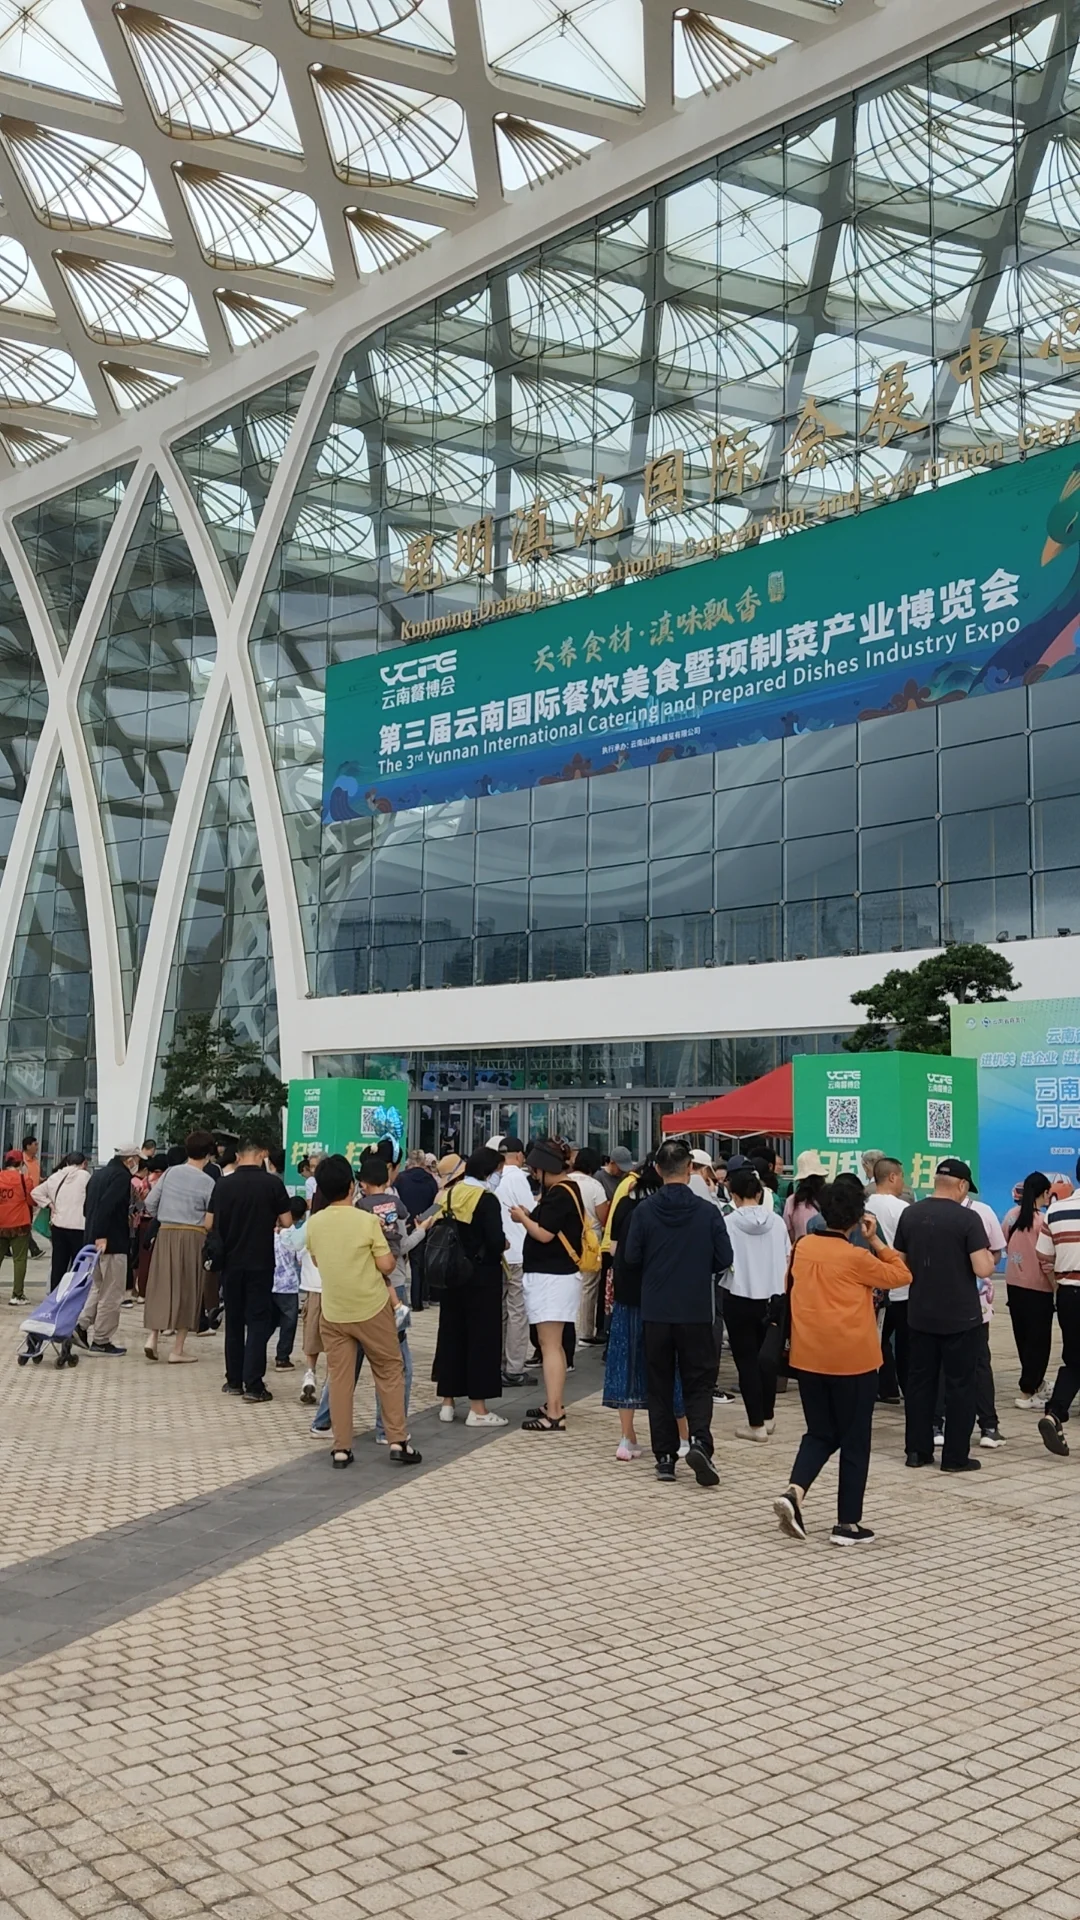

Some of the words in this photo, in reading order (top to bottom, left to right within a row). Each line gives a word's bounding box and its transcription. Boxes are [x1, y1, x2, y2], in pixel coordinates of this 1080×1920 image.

[404, 306, 1080, 593] 昆明滇池国际会展中心
[401, 608, 473, 640] Kunming
[479, 583, 543, 620] Dianchi
[550, 544, 672, 600] International
[683, 506, 805, 559] Convention
[817, 482, 861, 517] and
[873, 443, 1004, 500] Exhibition
[378, 758, 403, 775] The
[406, 751, 424, 770] 3rd
[427, 744, 479, 765] Yunnan
[483, 717, 584, 754] International
[588, 703, 659, 733] Catering
[664, 691, 696, 716] and
[702, 667, 787, 707] Prepared
[794, 655, 859, 686] Dishes
[866, 632, 958, 668] Industry
[965, 617, 1021, 645] Expo
[379, 568, 1021, 756] 第三届云南国际餐饮美食暨预制菜产业博览会
[382, 675, 456, 711] 云南餐博会
[980, 1052, 1017, 1068] 进机关
[1020, 1050, 1058, 1067] 进企业
[1036, 1077, 1080, 1101] 云南
[1036, 1104, 1080, 1129] 万元
